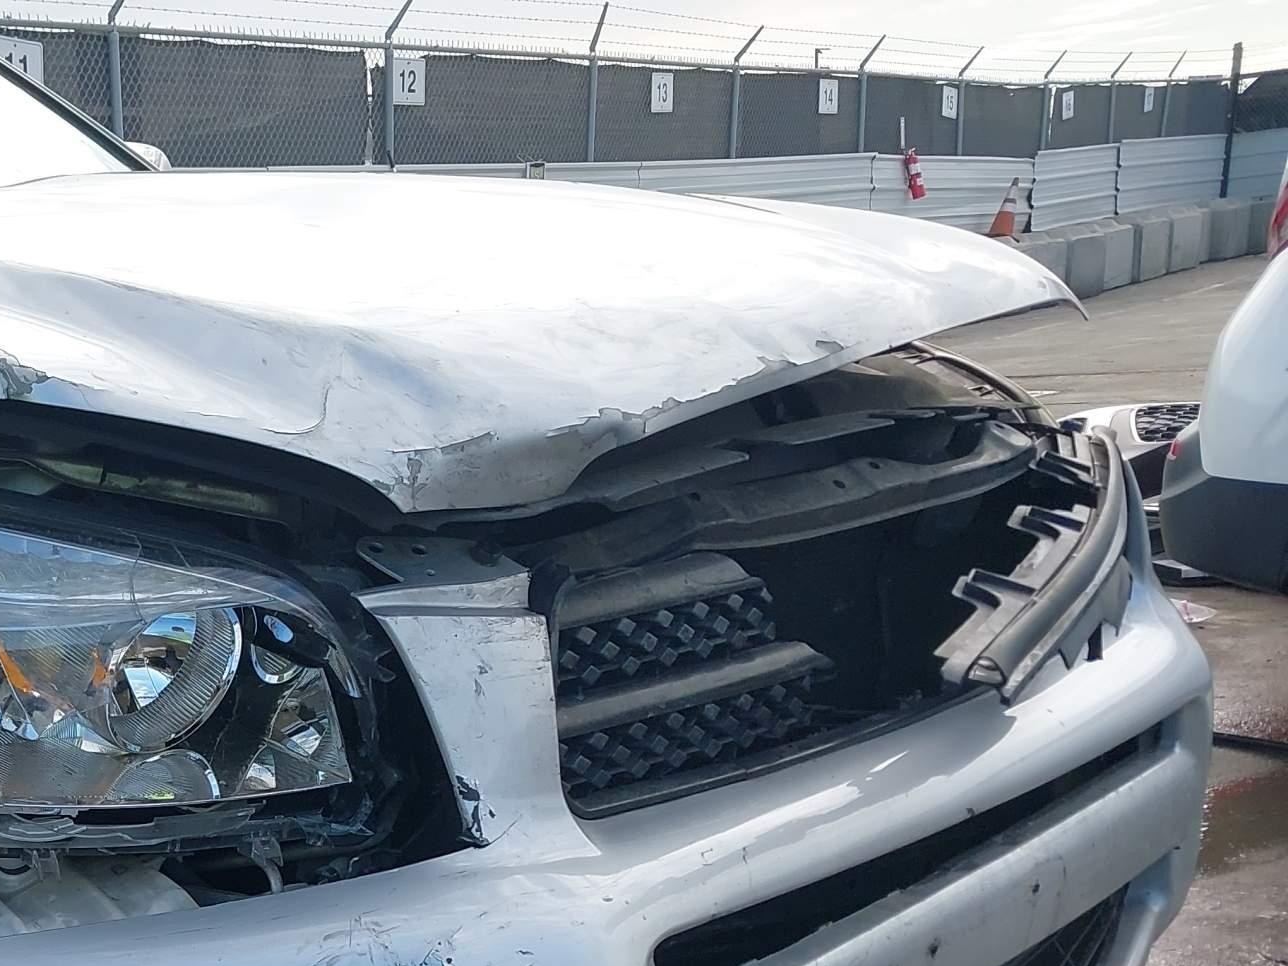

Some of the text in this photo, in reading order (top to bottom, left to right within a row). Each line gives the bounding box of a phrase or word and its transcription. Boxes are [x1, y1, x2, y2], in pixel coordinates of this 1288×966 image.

[399, 69, 417, 94] 12
[657, 82, 668, 103] 13
[824, 87, 834, 105] 14
[947, 94, 954, 111] 15
